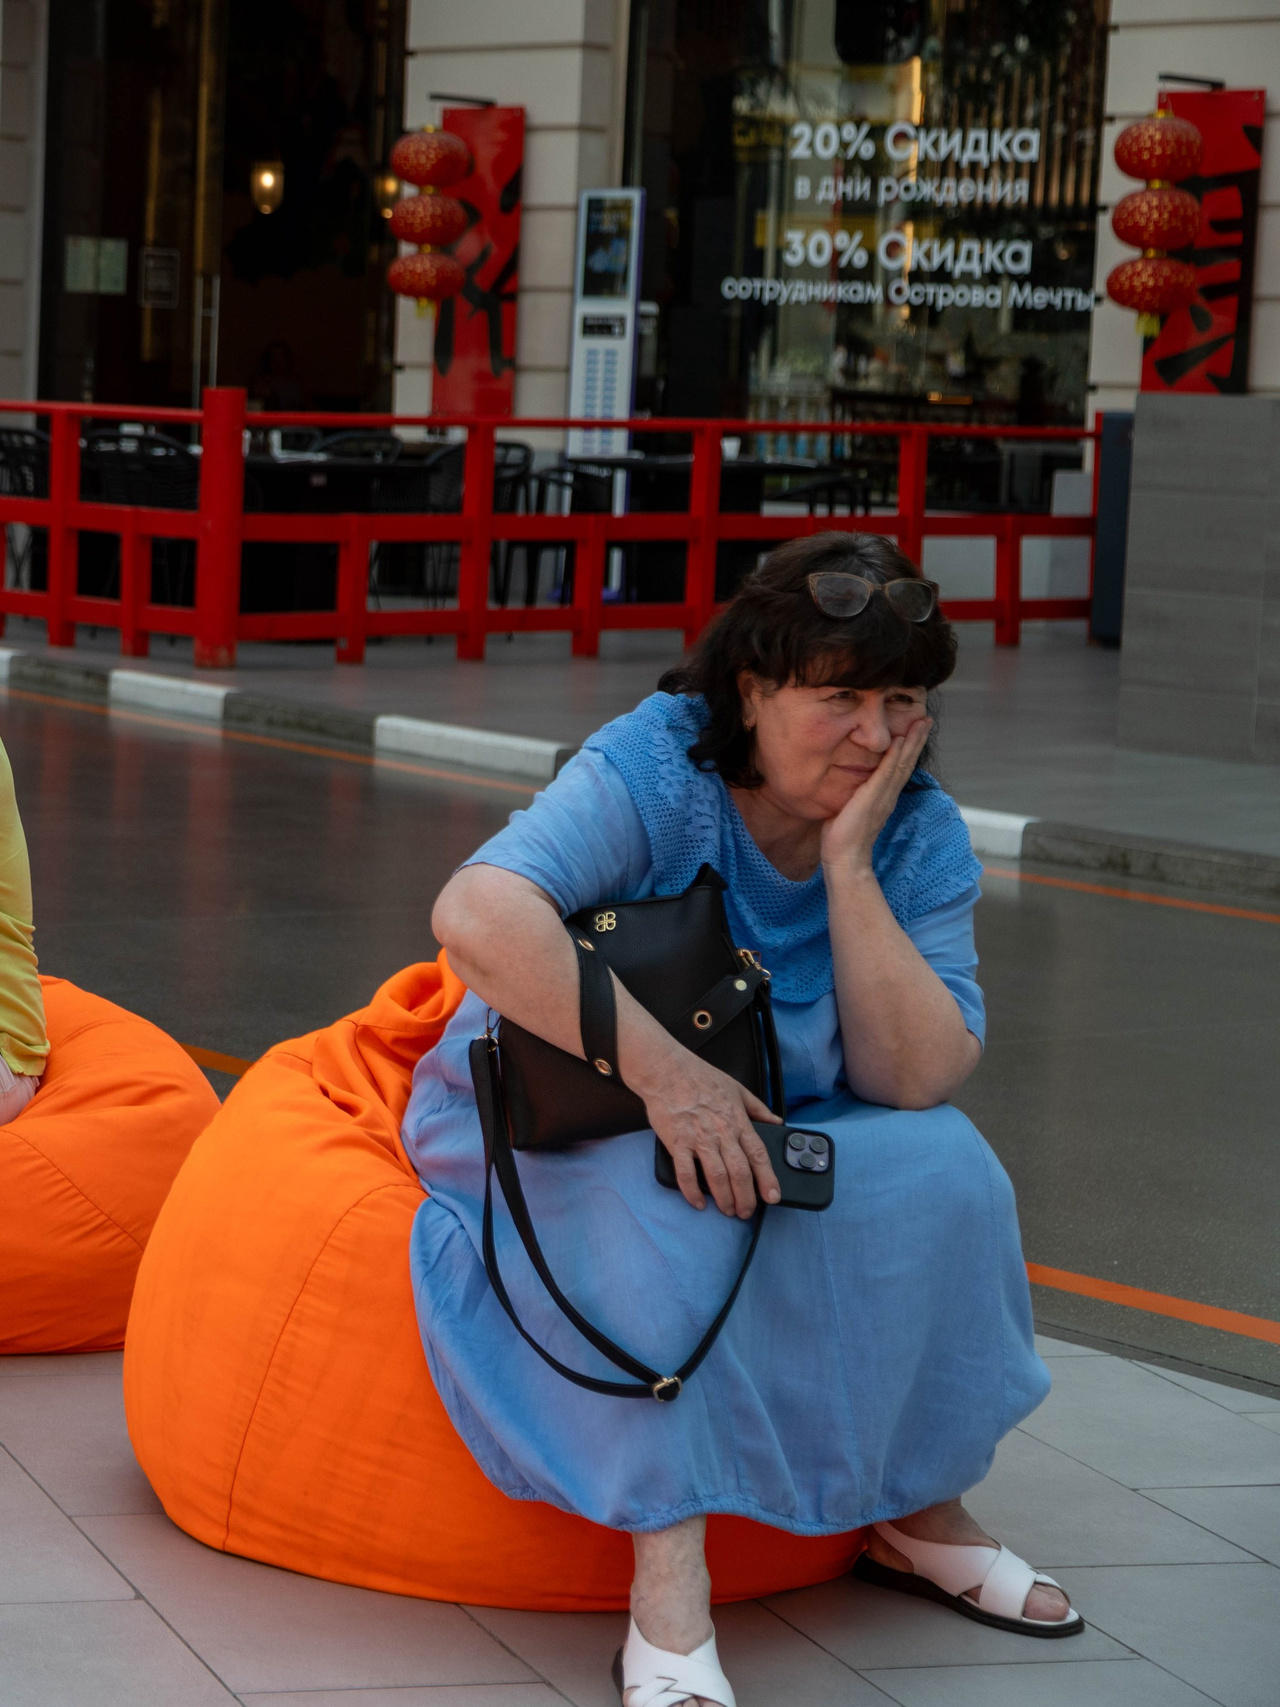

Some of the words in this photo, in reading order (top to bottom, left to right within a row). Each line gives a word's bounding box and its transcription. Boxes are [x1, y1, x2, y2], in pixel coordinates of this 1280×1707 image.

[790, 121, 875, 161] 20%
[884, 121, 1041, 169] Скидка
[793, 176, 811, 200] в
[815, 176, 871, 205] дни
[877, 176, 1031, 208] рождения
[782, 230, 869, 269] 30%
[878, 231, 1033, 279] Скидка
[720, 276, 883, 306] сотрудникам
[886, 278, 1003, 312] Острова
[1007, 282, 1096, 312] Мечты
